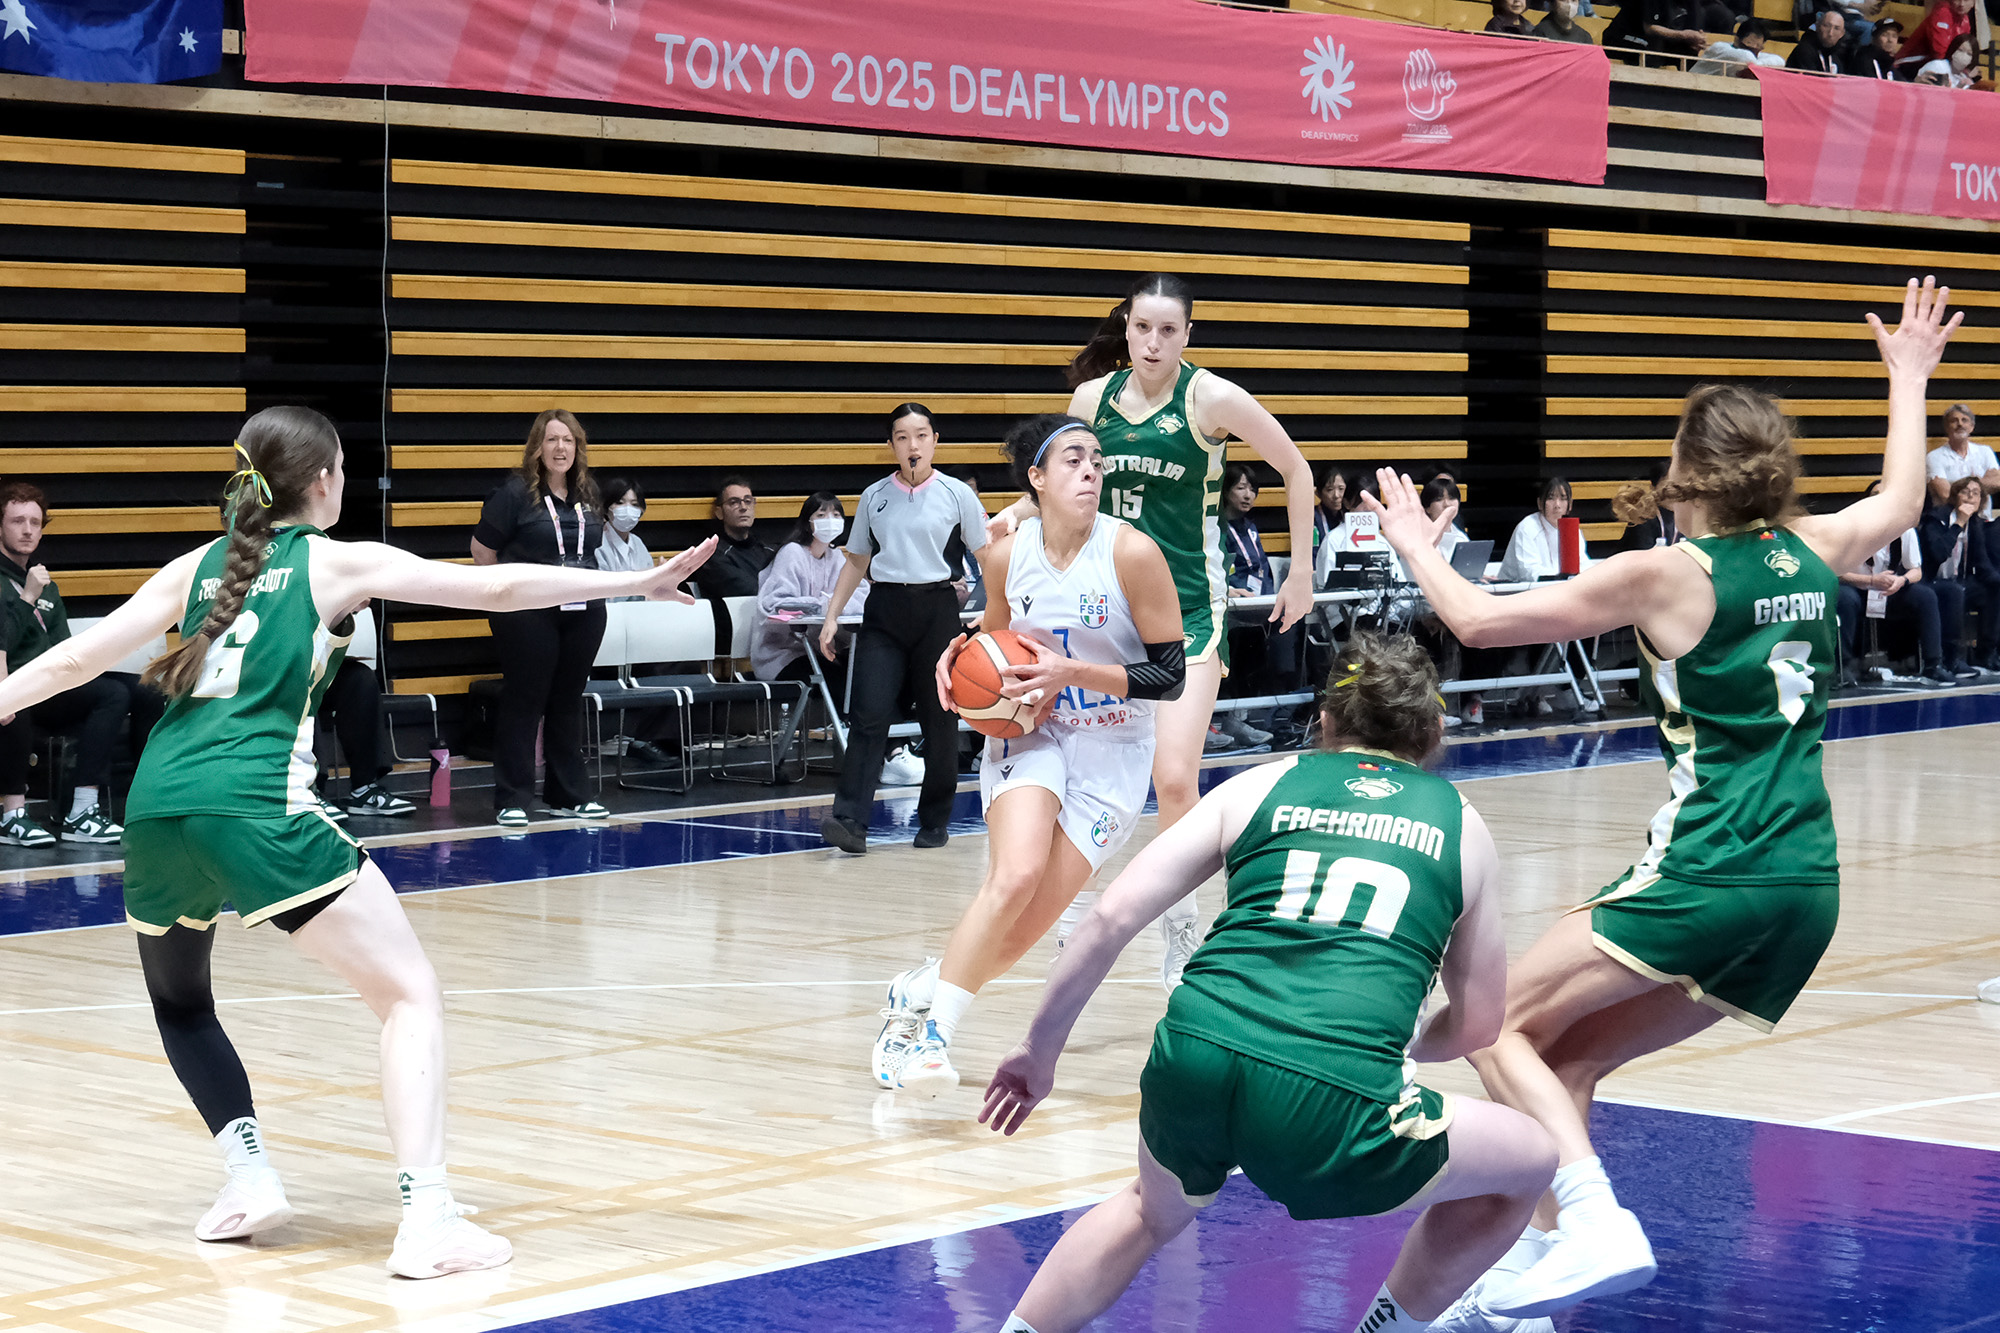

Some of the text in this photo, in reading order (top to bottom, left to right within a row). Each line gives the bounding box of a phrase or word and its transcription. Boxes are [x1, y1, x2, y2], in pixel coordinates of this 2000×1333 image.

[655, 33, 1230, 137] TOKYO 2025 DEAFLYMPICS
[1301, 130, 1359, 142] DEAFLYMPICS
[1951, 162, 2000, 202] TOK
[1112, 484, 1145, 519] 15
[1754, 592, 1826, 625] GRADY
[1052, 629, 1072, 659] 7
[1270, 805, 1446, 862] FAEHRMANN
[1269, 849, 1411, 940] 10
